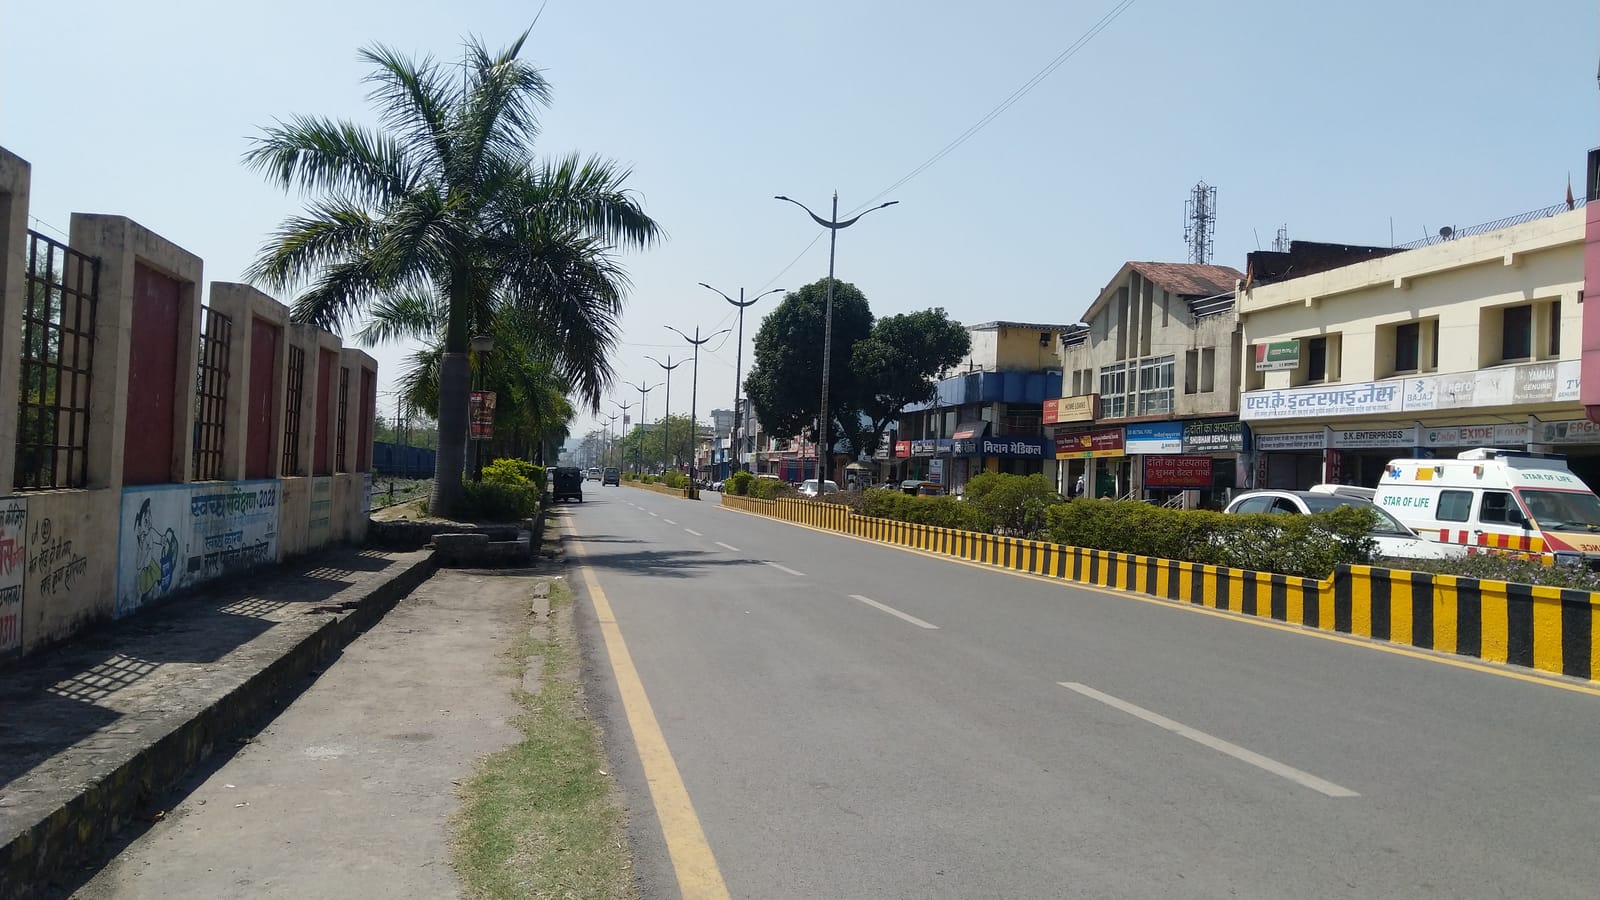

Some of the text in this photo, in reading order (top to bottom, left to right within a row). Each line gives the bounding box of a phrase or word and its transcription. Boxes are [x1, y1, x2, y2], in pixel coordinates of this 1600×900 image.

[1407, 391, 1433, 402] BAJAJ
[1211, 435, 1229, 443] DENTAL
[1356, 430, 1403, 440] ENTERPRISES
[1460, 428, 1493, 440] EXIDE
[983, 440, 1008, 453] निदान
[1009, 442, 1041, 455] मेडिकल
[1177, 459, 1210, 468] अस्पताल
[1522, 473, 1542, 481] STAR
[1556, 475, 1573, 483] LIFE
[1383, 496, 1430, 508] STAR OF LIFE
